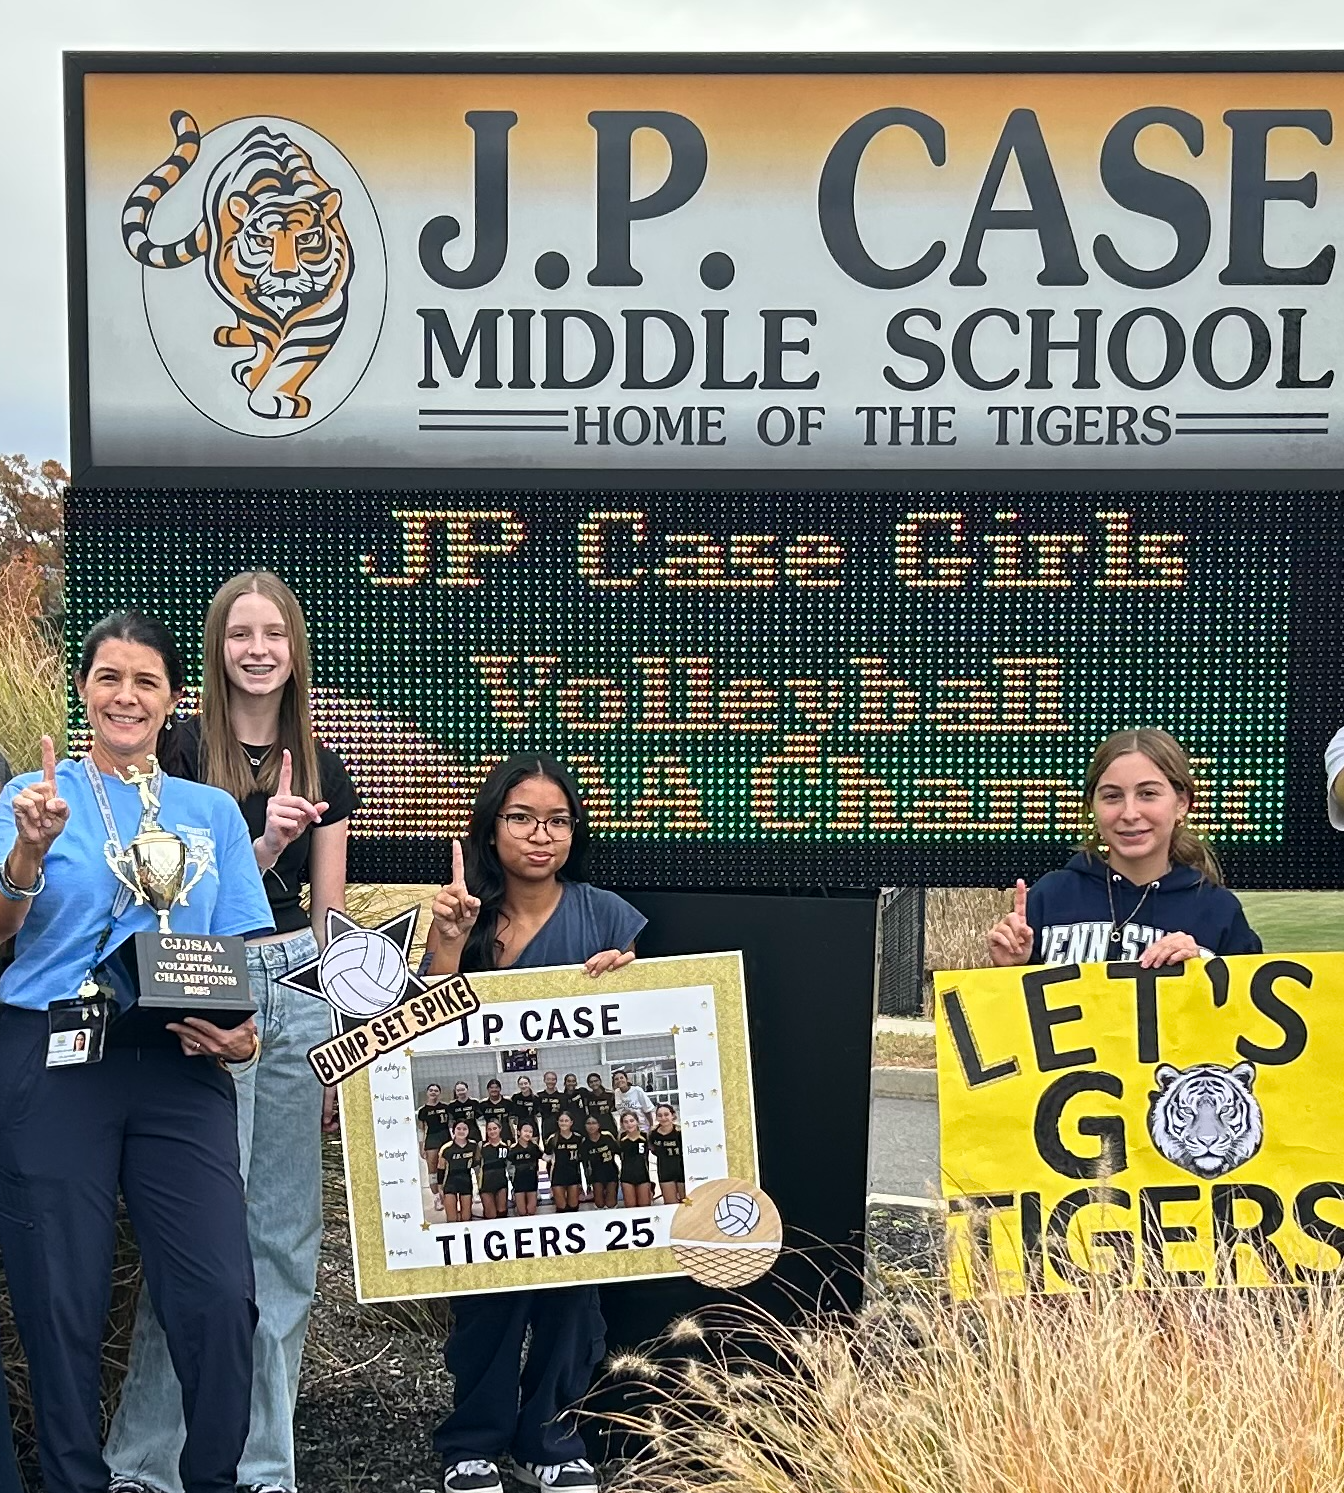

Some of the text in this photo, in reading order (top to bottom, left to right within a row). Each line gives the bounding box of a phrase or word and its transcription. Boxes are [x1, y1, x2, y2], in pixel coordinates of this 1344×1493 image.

[418, 106, 1336, 291] J.P. CASE
[416, 306, 1335, 392] MIDDLE SCHOOL
[573, 405, 1172, 447] HOME OF THE TIGERS
[358, 509, 1189, 589] JP Case Girls
[468, 654, 1072, 754] Volleyball
[156, 961, 233, 974] VOLLEYBALL
[160, 937, 226, 953] CJJSAA
[175, 953, 213, 963] GIRLS
[153, 971, 238, 986] CHAMPIONS
[314, 980, 473, 1082] BUMP SET SPIKE
[519, 1003, 622, 1042] CASE
[939, 957, 1314, 1090] LET'S
[638, 1142, 645, 1154] 5
[435, 1217, 655, 1266] TIGERS 25
